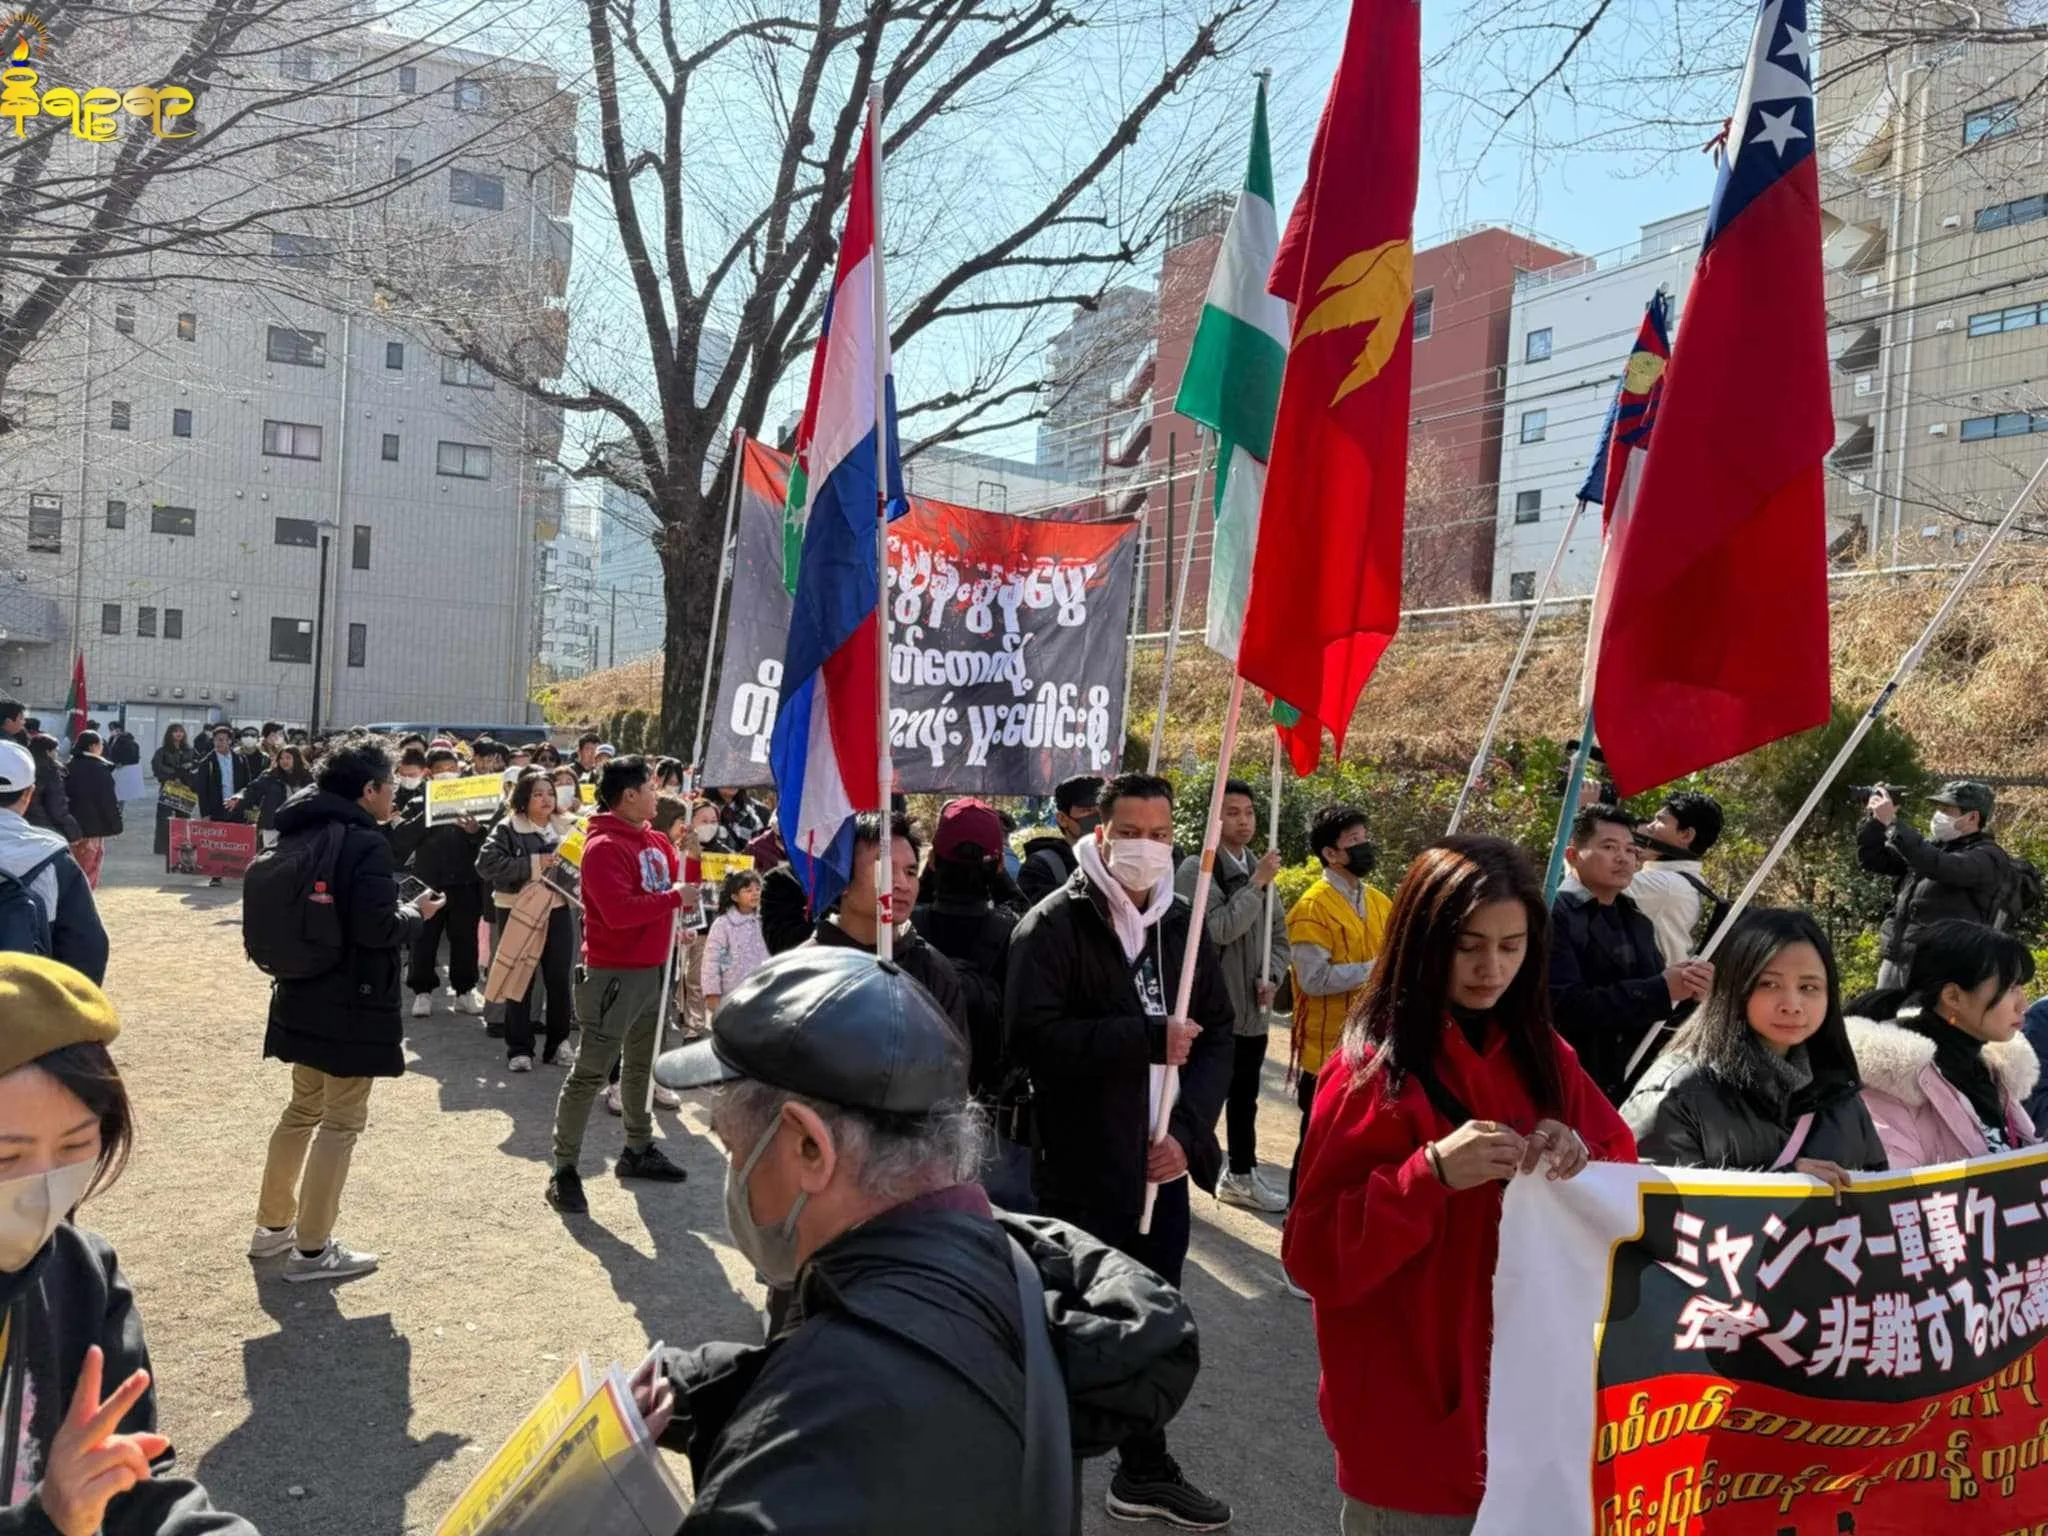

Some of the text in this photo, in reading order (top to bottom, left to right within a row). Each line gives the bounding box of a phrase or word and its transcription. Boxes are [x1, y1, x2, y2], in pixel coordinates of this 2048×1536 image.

[1655, 1180, 2048, 1298] ミャンマー軍事クー
